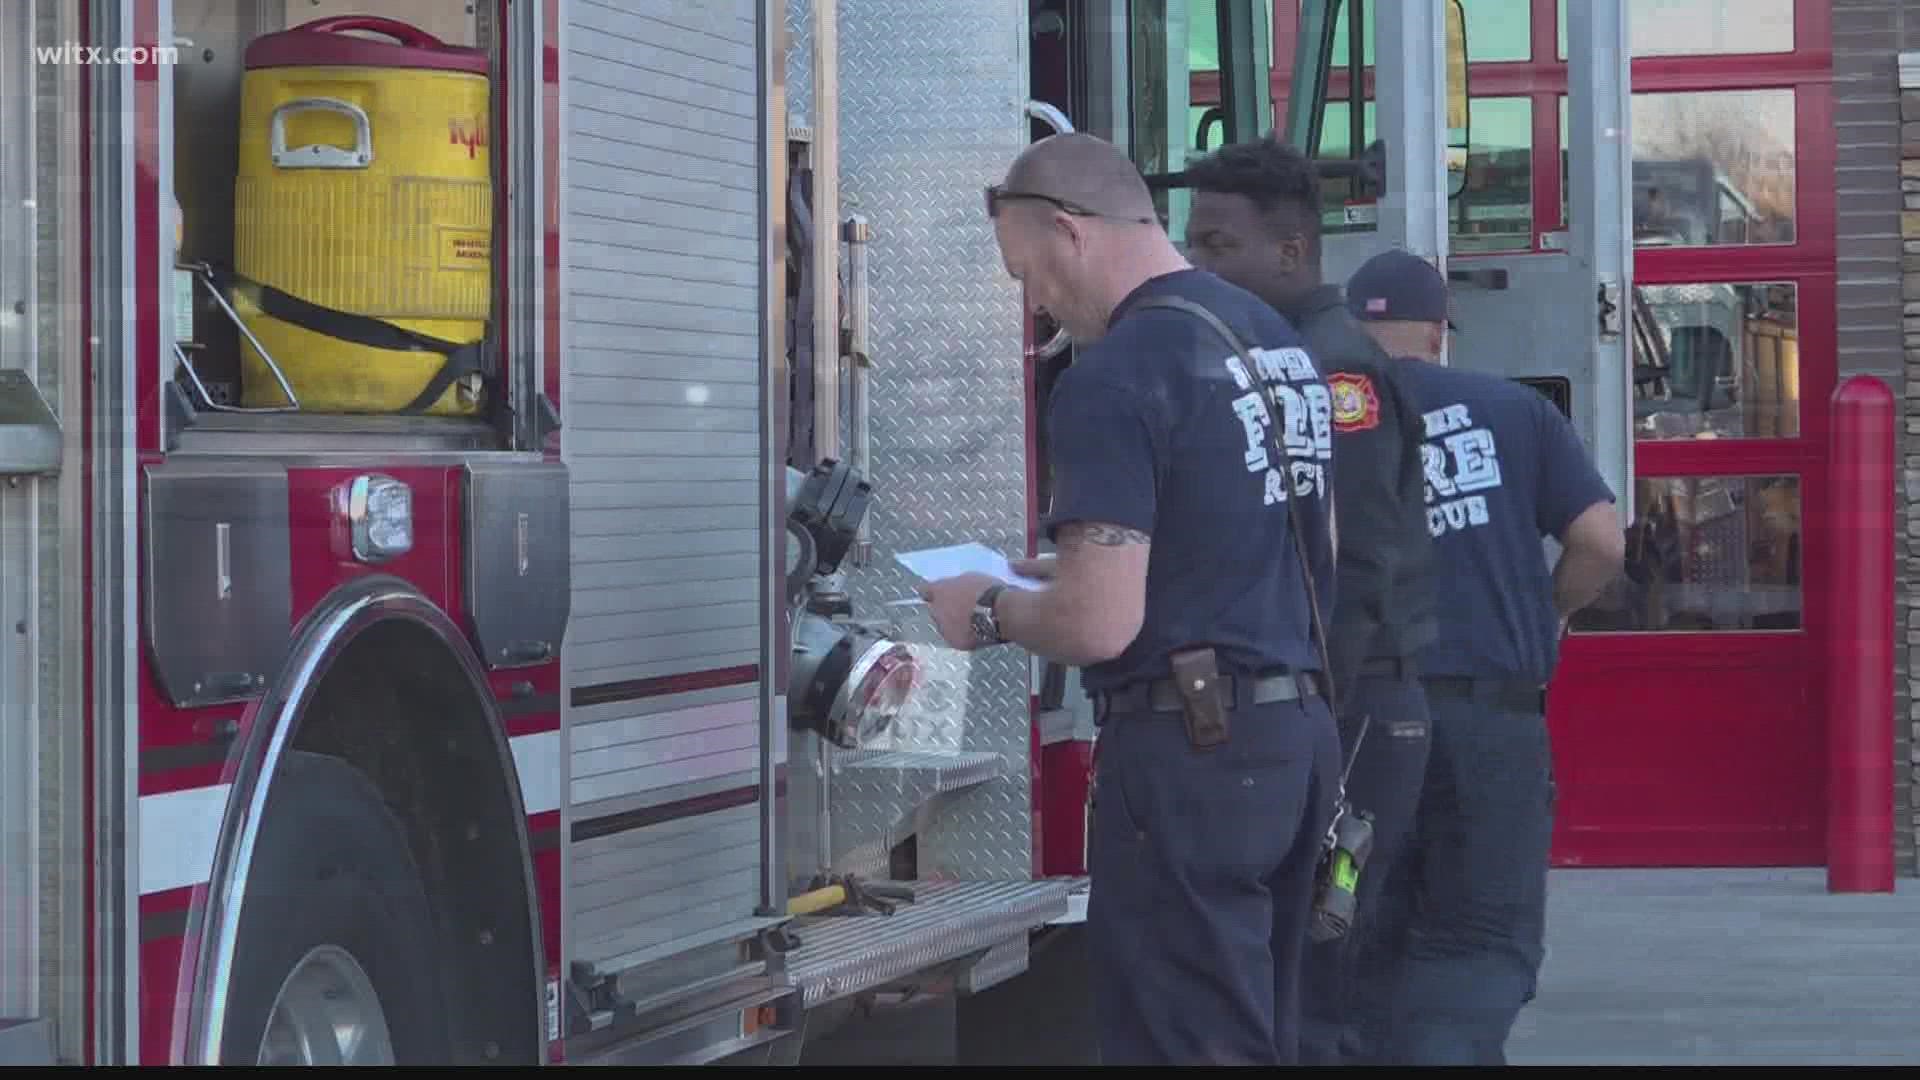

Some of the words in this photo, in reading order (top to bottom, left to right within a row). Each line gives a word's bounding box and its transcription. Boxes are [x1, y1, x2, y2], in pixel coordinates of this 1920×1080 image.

[1232, 384, 1332, 473] FRE
[1421, 428, 1503, 505] RE
[1425, 494, 1490, 537] CUE
